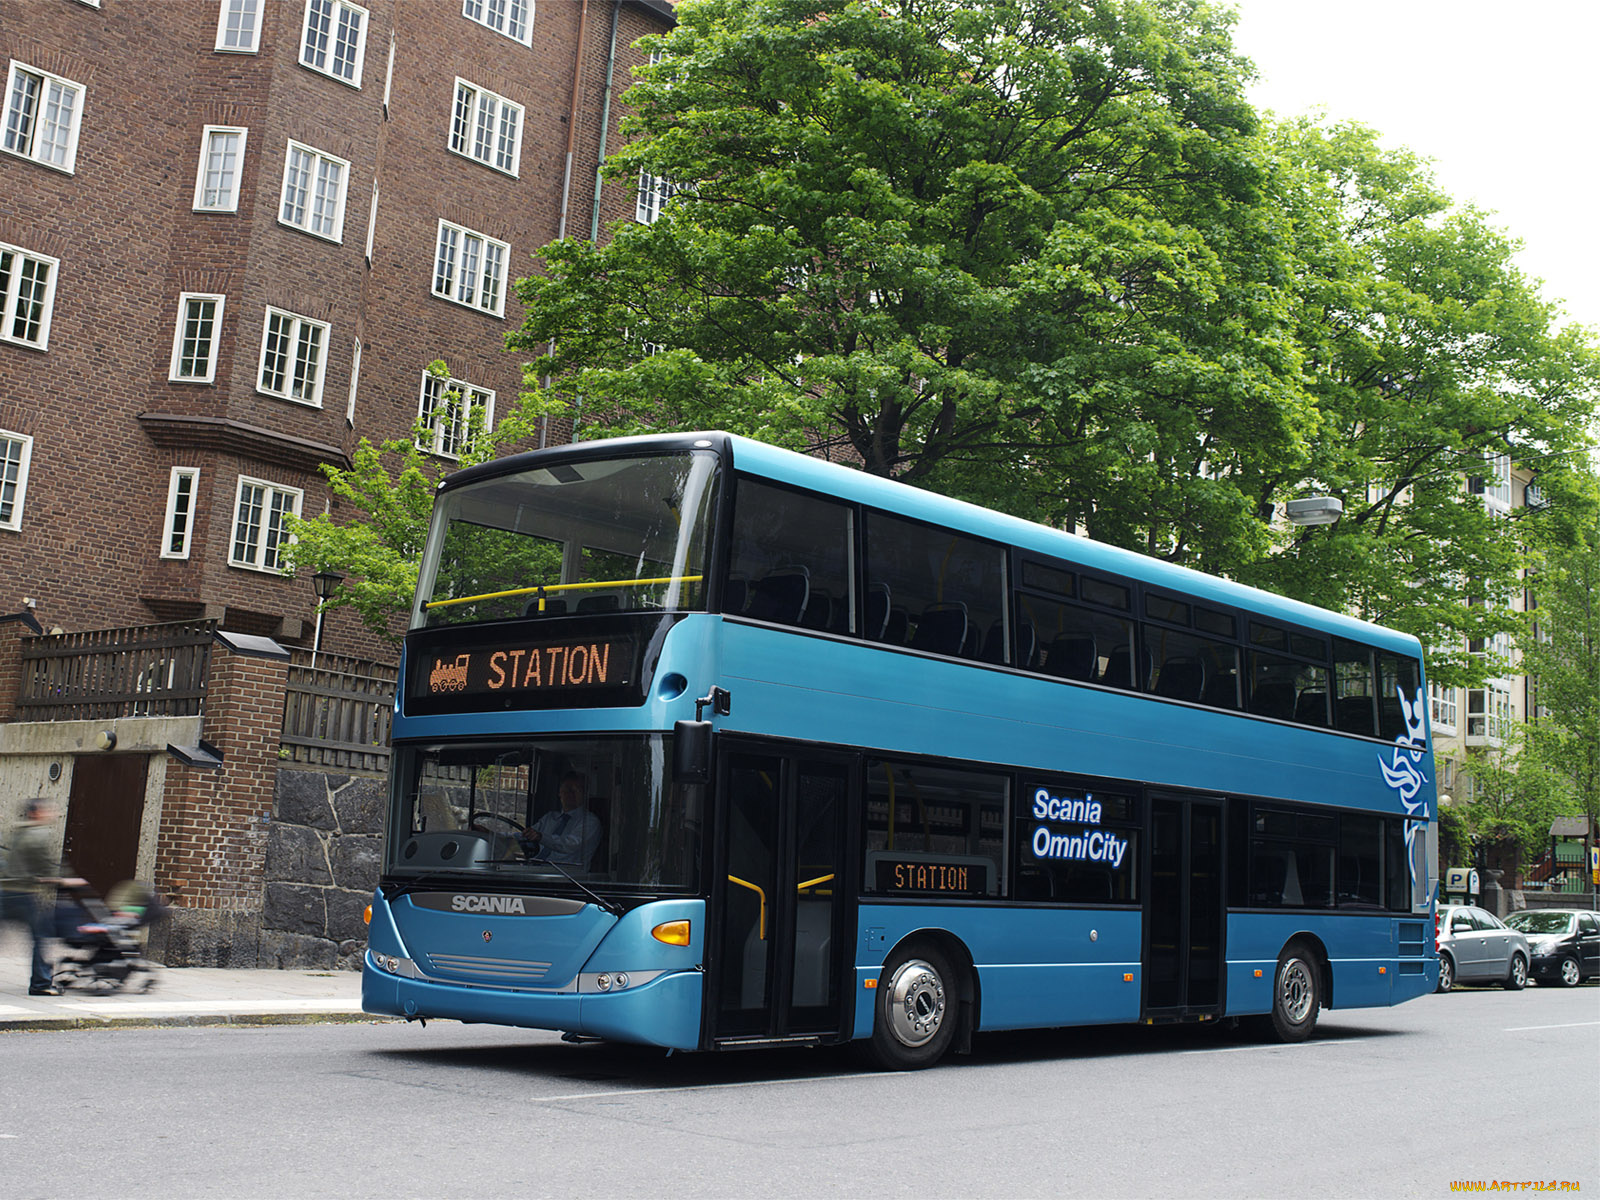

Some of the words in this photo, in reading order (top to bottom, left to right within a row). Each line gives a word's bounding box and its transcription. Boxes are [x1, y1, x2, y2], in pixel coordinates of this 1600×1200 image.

[488, 643, 609, 689] STATION
[1033, 788, 1102, 824] Scania
[1033, 826, 1128, 868] OmniCity
[895, 864, 968, 891] STATION
[1451, 874, 1462, 885] P
[451, 895, 526, 914] SCANIA
